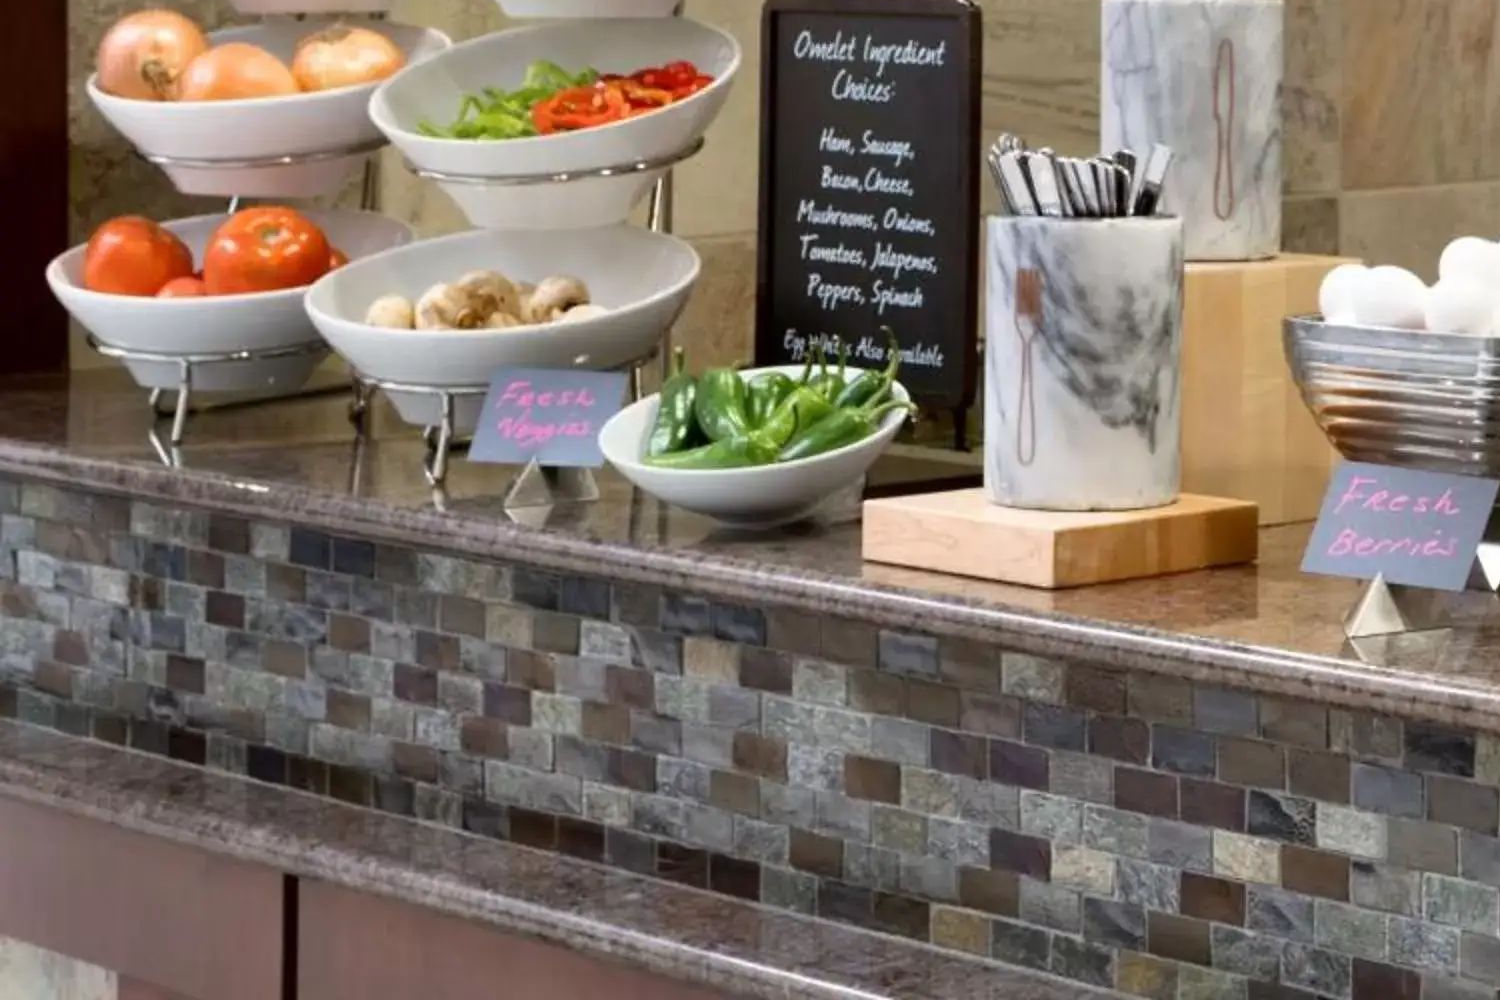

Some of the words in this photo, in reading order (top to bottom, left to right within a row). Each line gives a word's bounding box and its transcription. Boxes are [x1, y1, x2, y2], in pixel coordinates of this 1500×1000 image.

[793, 30, 857, 62] Omelet
[863, 35, 946, 77] Ingredient
[1326, 527, 1458, 558] Berries
